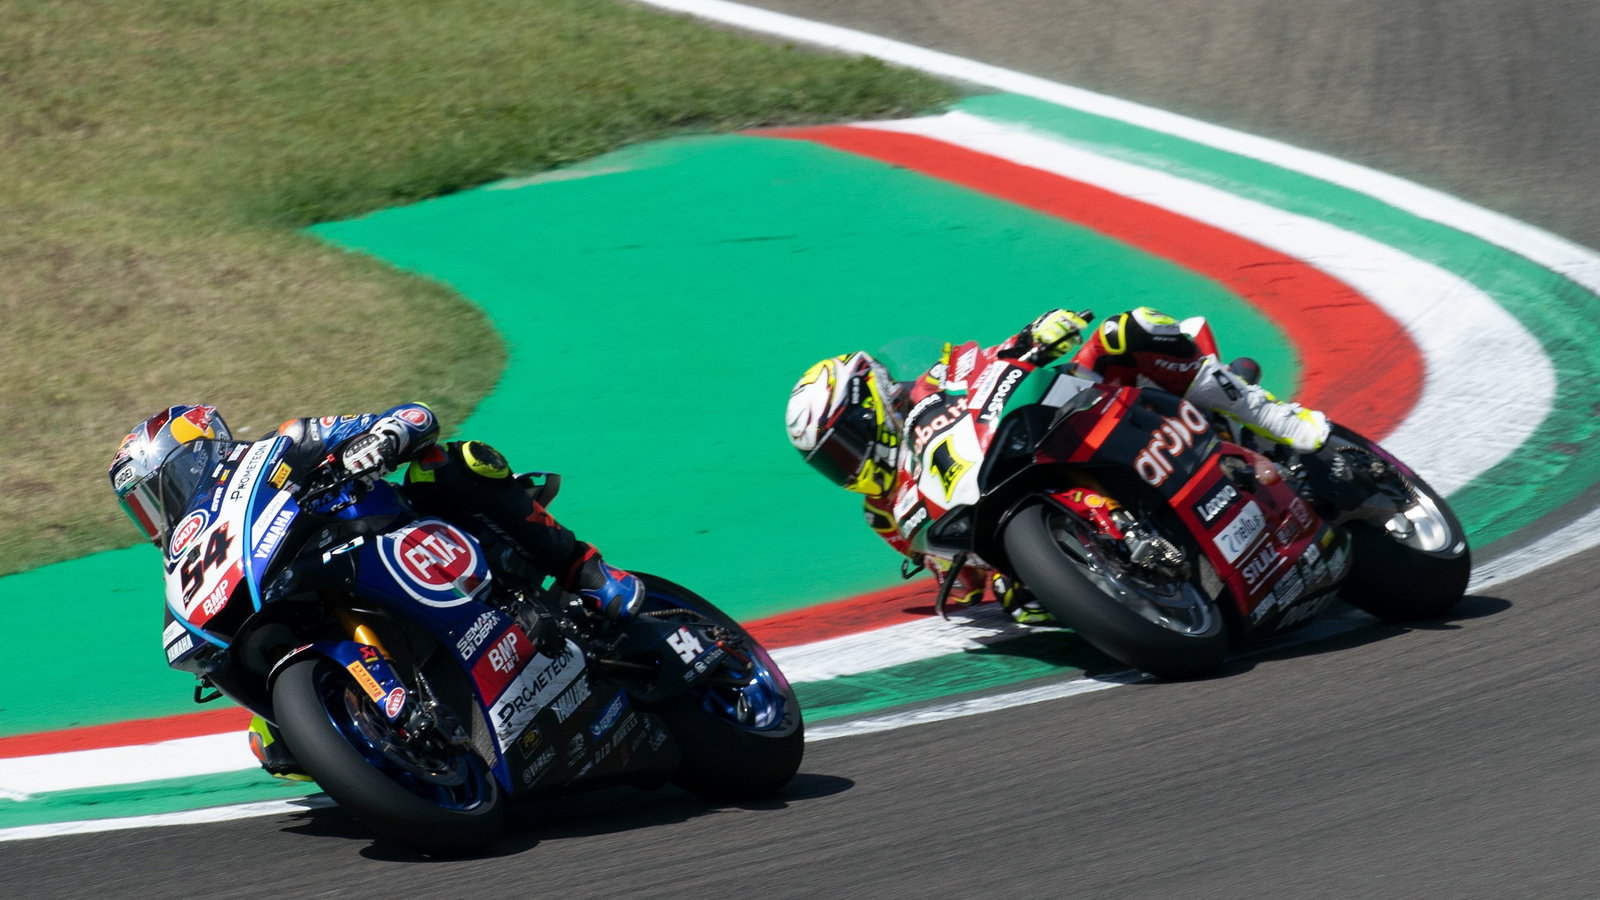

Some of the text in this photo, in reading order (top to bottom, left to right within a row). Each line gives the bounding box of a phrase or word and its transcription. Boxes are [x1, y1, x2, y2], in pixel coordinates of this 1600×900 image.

[980, 368, 1023, 421] Lenovo
[230, 444, 267, 502] PROMETEON
[1197, 485, 1237, 522] Lenovo
[174, 521, 199, 551] PATA
[253, 509, 295, 559] YAMAHA
[404, 530, 467, 580] PATA
[180, 523, 236, 611] 54
[202, 580, 229, 616] BMP
[488, 632, 518, 673] BMP
[666, 626, 704, 665] 54
[498, 646, 575, 728] PROMETEON
